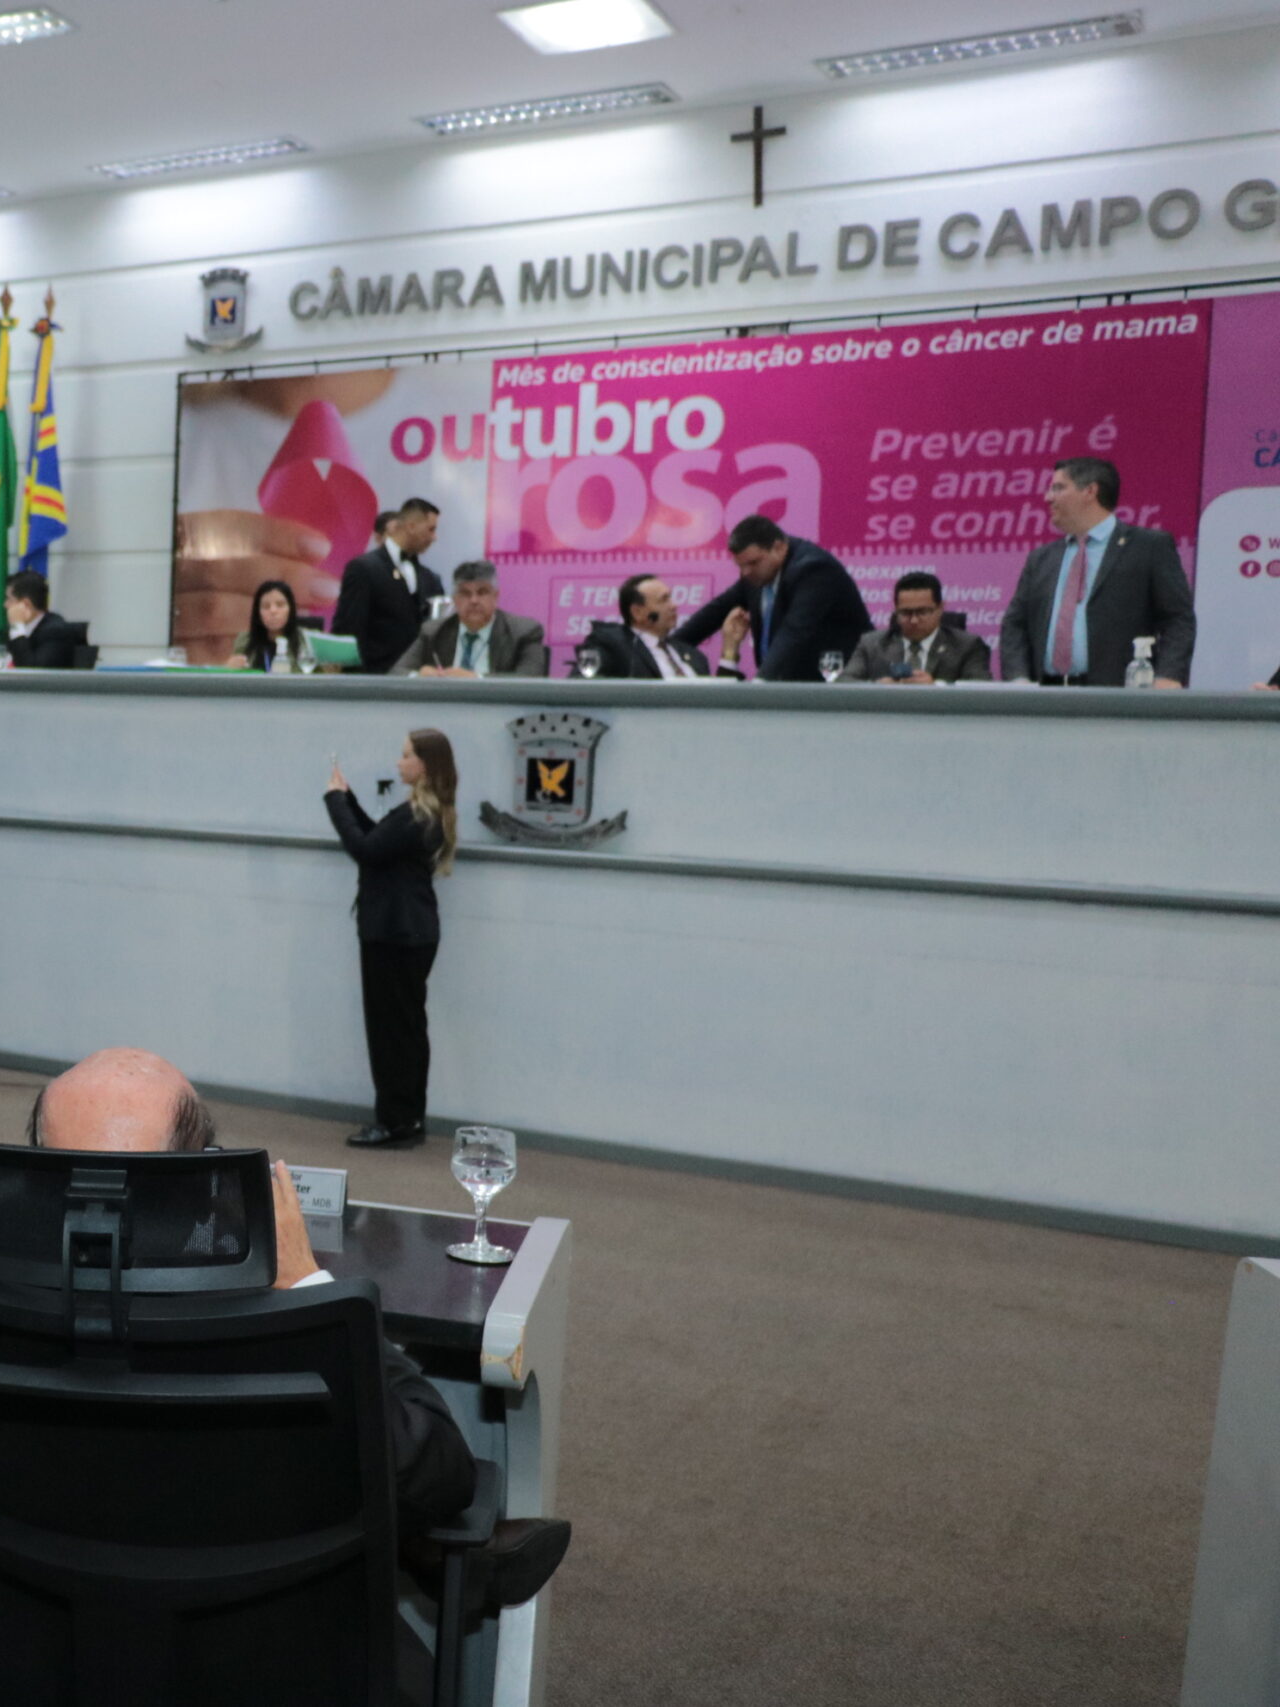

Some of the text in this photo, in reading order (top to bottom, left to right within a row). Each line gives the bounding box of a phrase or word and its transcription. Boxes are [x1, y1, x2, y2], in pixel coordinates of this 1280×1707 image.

[289, 267, 504, 321] CÂMARA
[520, 232, 817, 303] MUNICIPAL
[837, 218, 920, 271] DE
[938, 188, 1200, 260] CAMPO
[497, 313, 1198, 388] Mês de conscientização sobre o câncer de mama
[390, 383, 724, 465] outubro
[870, 415, 1118, 462] Prevenir é
[490, 442, 822, 551] rosa
[866, 472, 917, 501] se
[865, 503, 1160, 542] se conher.
[559, 583, 575, 607] É
[670, 585, 704, 605] DE
